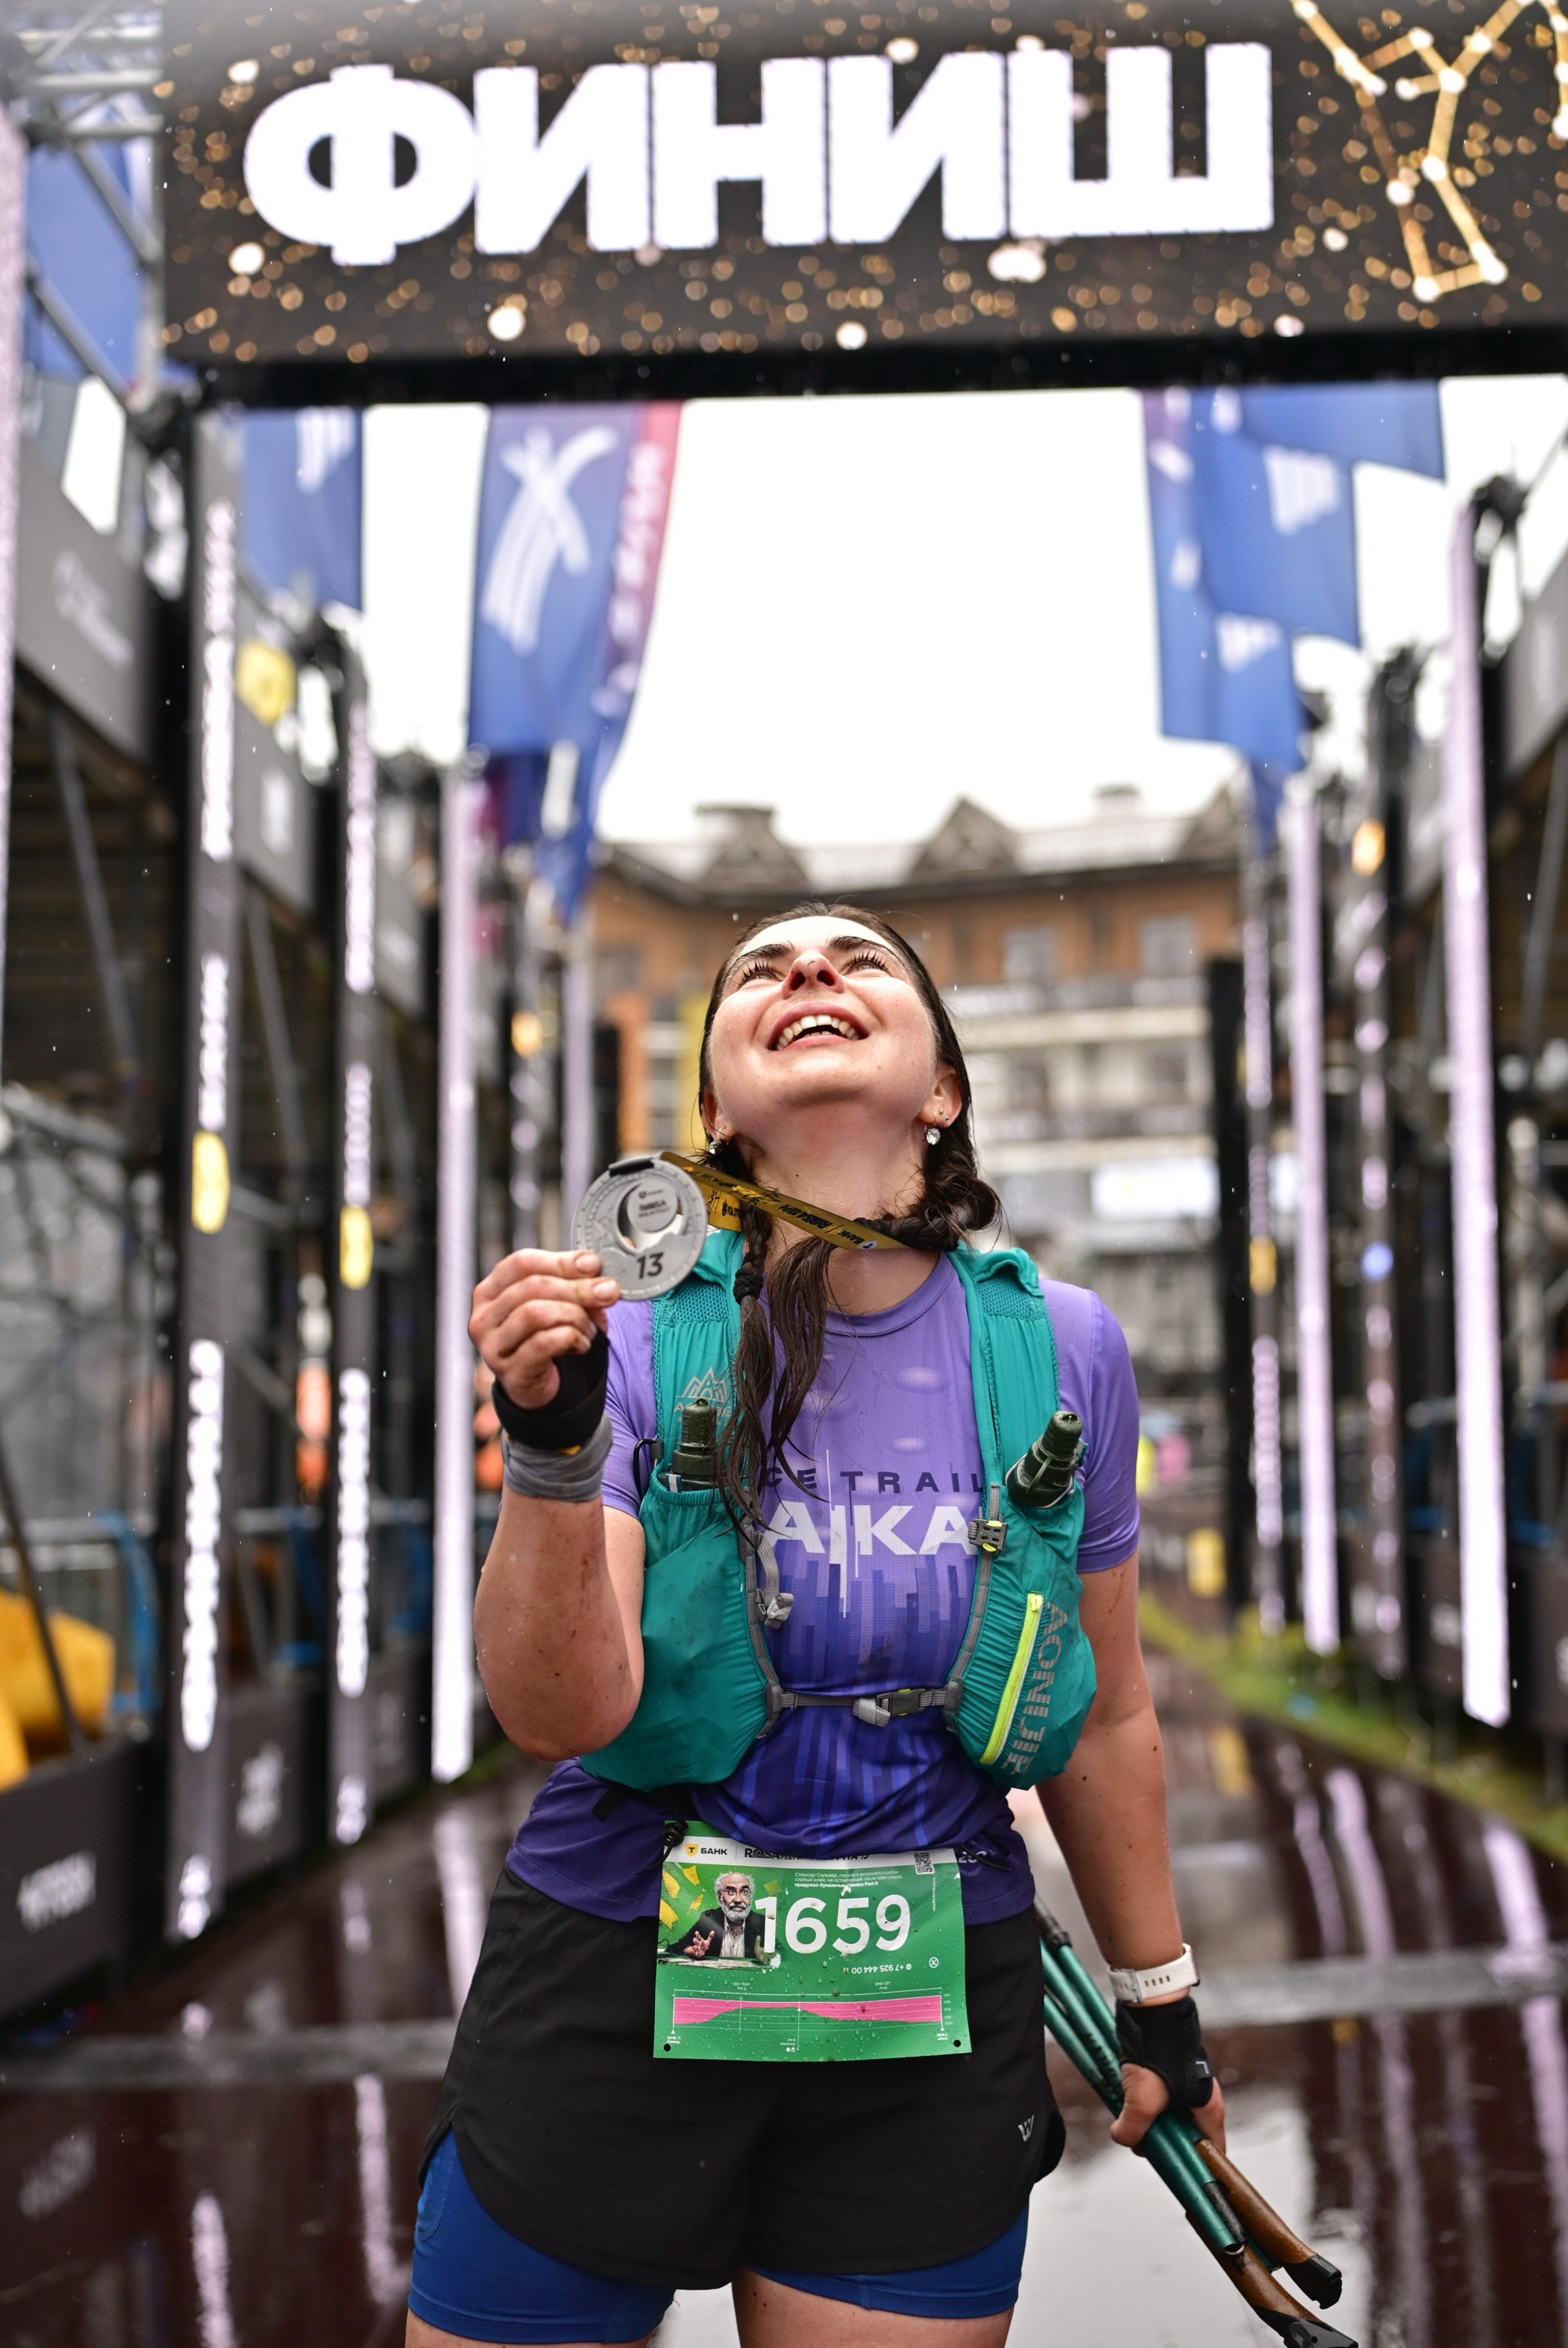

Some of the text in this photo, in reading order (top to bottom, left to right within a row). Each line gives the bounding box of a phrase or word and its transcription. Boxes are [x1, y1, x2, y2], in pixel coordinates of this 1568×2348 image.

[243, 43, 1275, 267] ФИНИШ
[636, 1251, 664, 1280] 13
[764, 1466, 984, 1494] CE TRAIL
[762, 1500, 983, 1558] AIKA
[1001, 1601, 1068, 1775] AONIJIE
[700, 1847, 728, 1856] БАНК
[754, 1894, 911, 1955] 1659
[879, 1964, 894, 1972] 925
